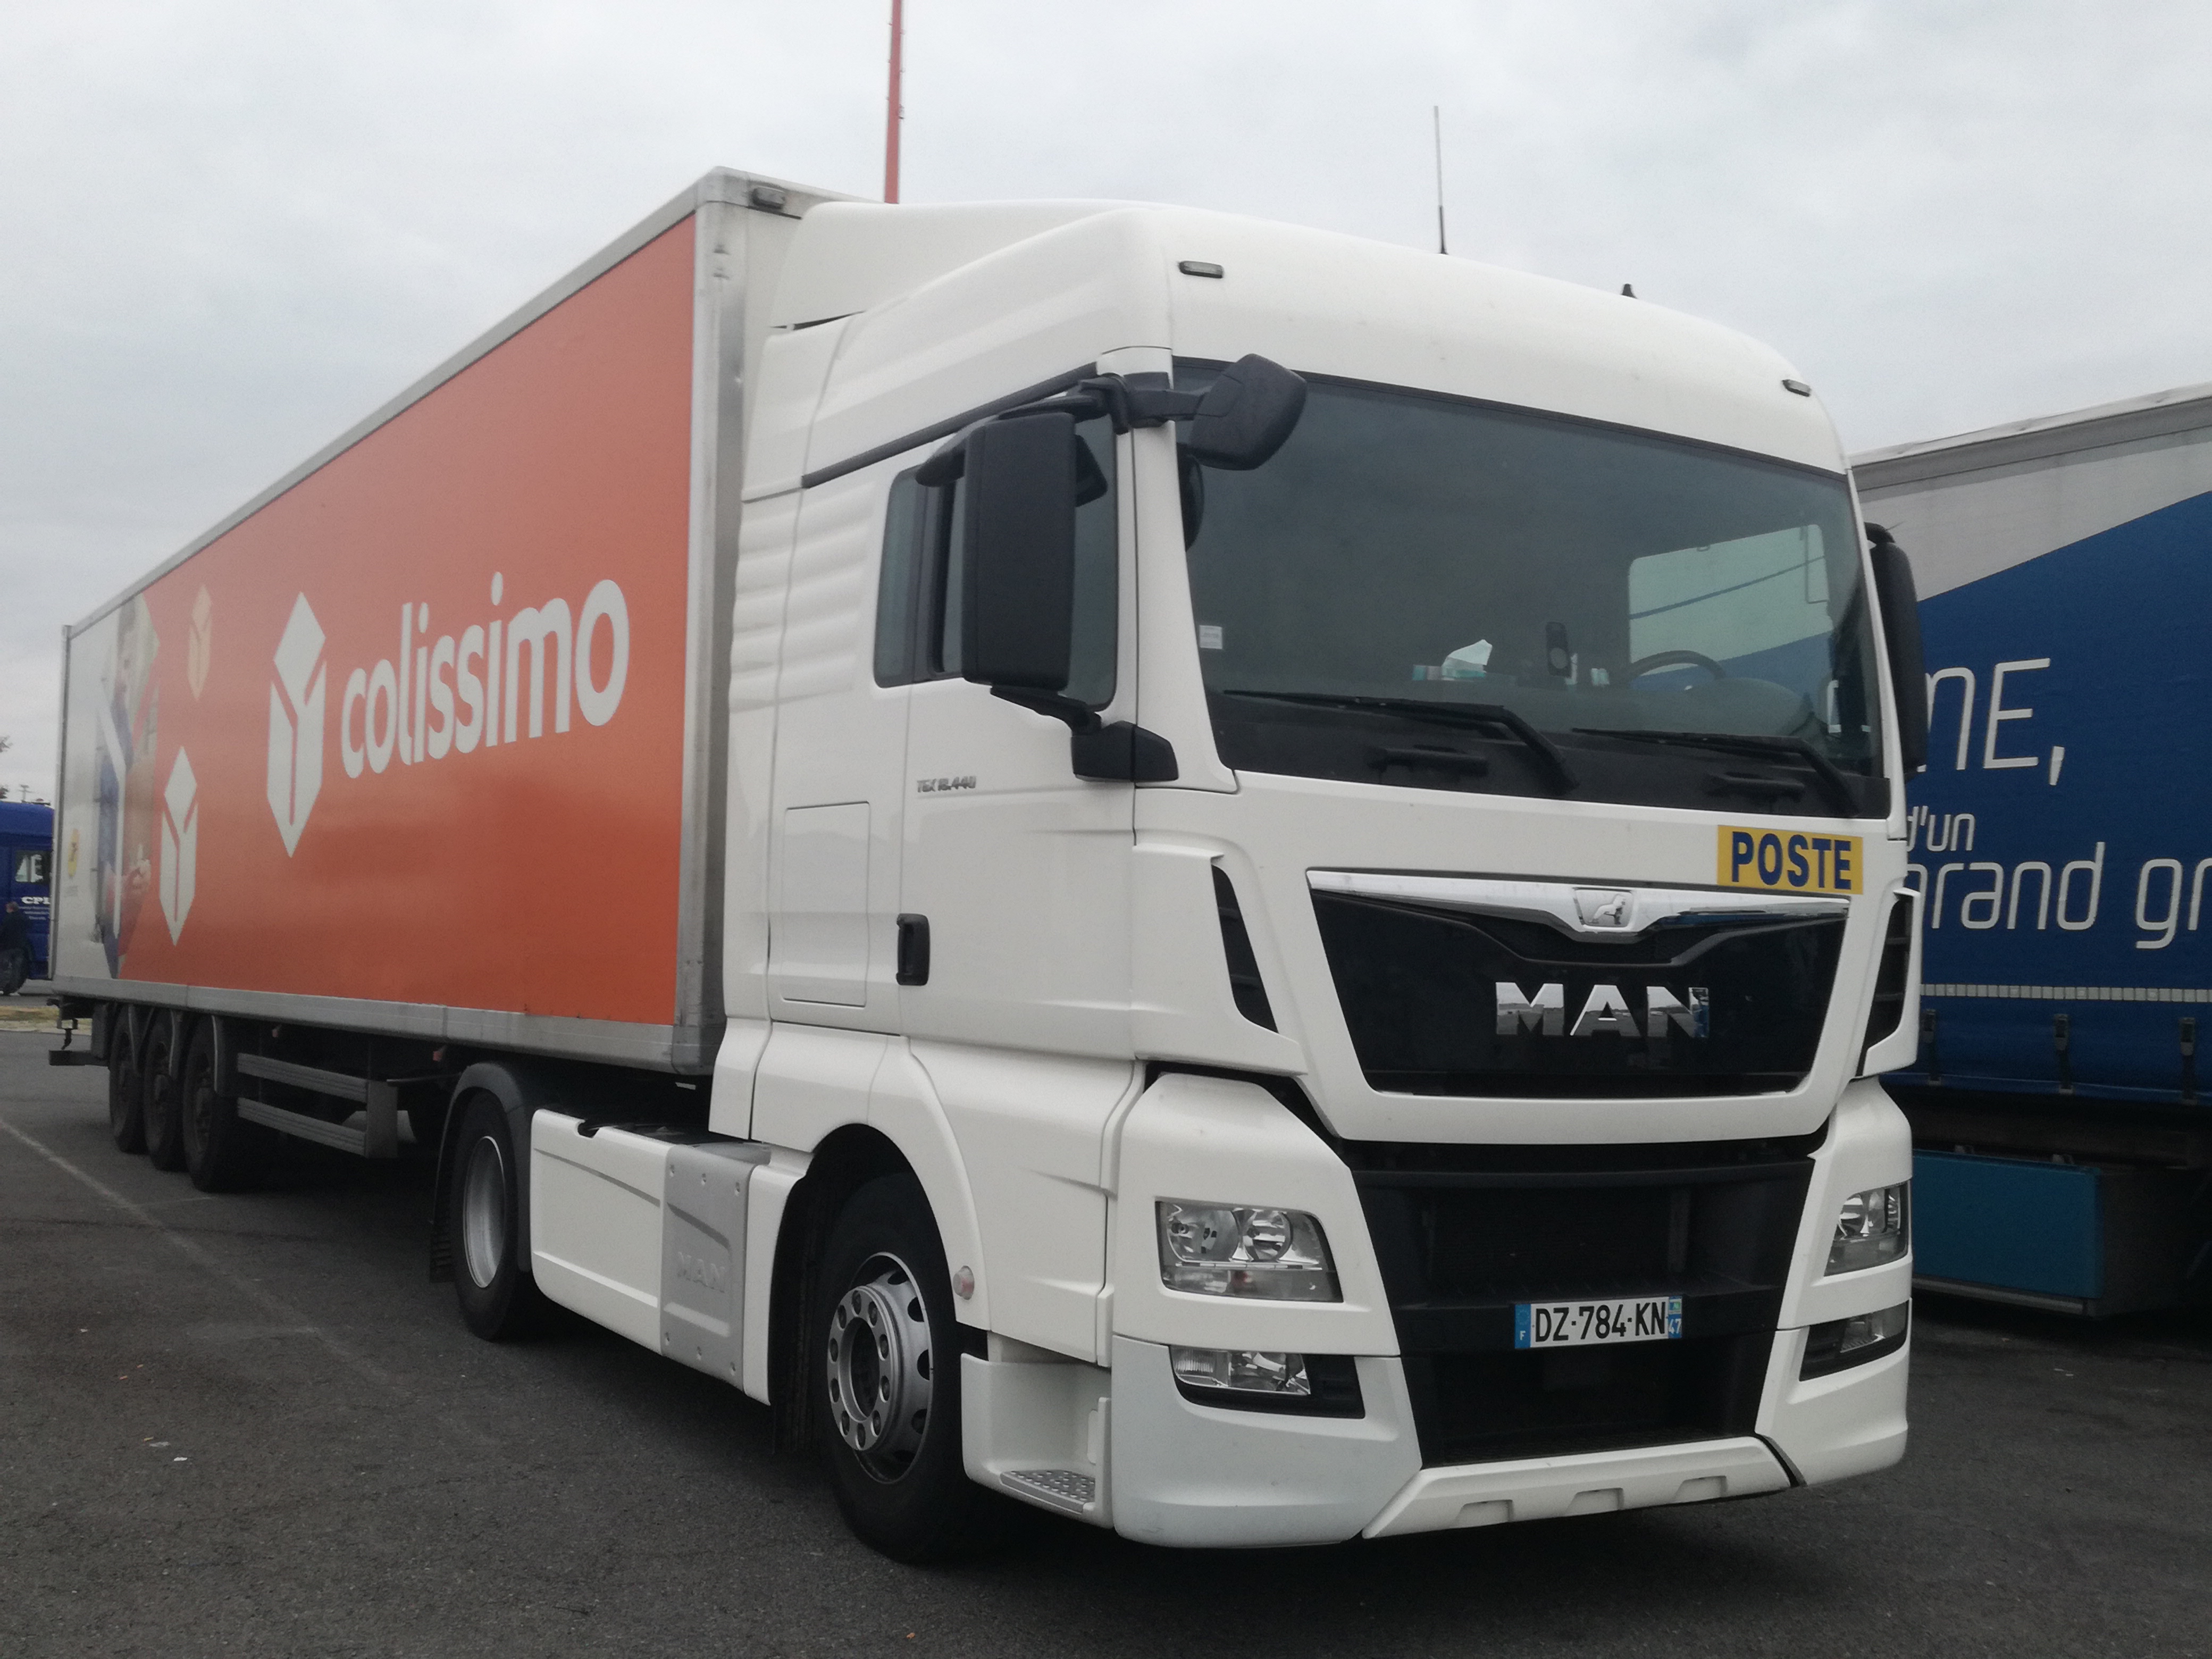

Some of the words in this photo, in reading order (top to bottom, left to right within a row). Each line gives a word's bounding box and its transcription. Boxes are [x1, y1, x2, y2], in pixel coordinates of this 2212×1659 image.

[341, 571, 630, 779] colissimo
[1732, 831, 1851, 890] POSTE
[1496, 982, 1710, 1037] MAN
[1519, 1330, 1527, 1340] F
[1535, 1301, 1666, 1343] DZ-784-KN
[1668, 1318, 1682, 1334] 47
